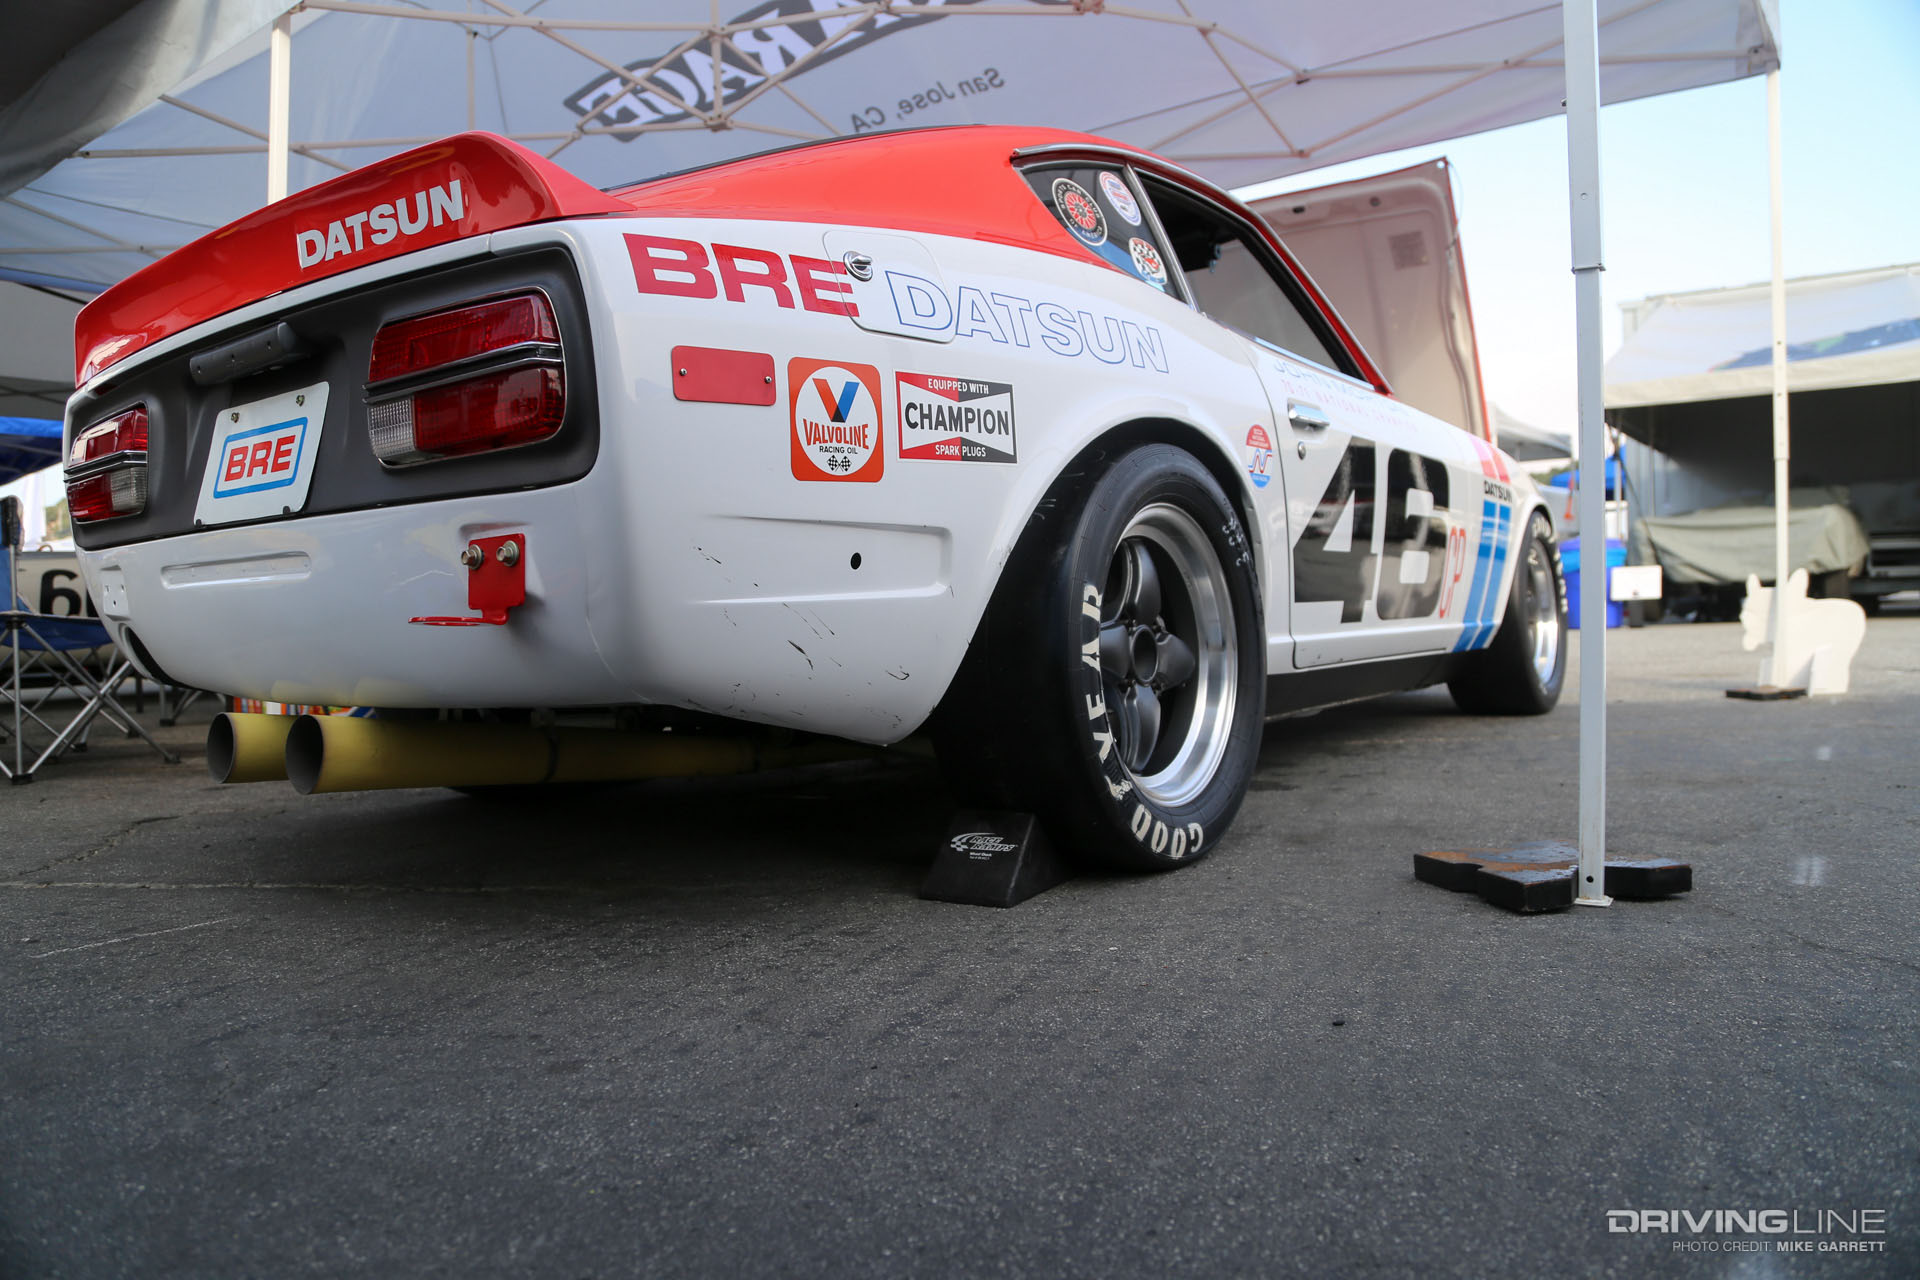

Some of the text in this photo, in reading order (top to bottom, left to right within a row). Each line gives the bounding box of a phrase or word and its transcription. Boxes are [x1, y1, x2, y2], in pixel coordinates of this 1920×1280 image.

[297, 179, 465, 270] DATSUN
[622, 232, 1169, 374] BRE DATSUN
[928, 378, 989, 394] EQUIPPED WITH
[802, 418, 869, 450] VALVOLINE
[904, 402, 1010, 436] CHAMPION
[224, 434, 297, 482] BRE
[819, 445, 858, 455] RACING OIL
[935, 444, 987, 457] SPARK PLUGS
[1483, 479, 1513, 503] DATSUN
[1293, 435, 1450, 624] 46
[1439, 526, 1467, 619] CP
[40, 569, 99, 618] 6
[970, 843, 1016, 852] RAMPS
